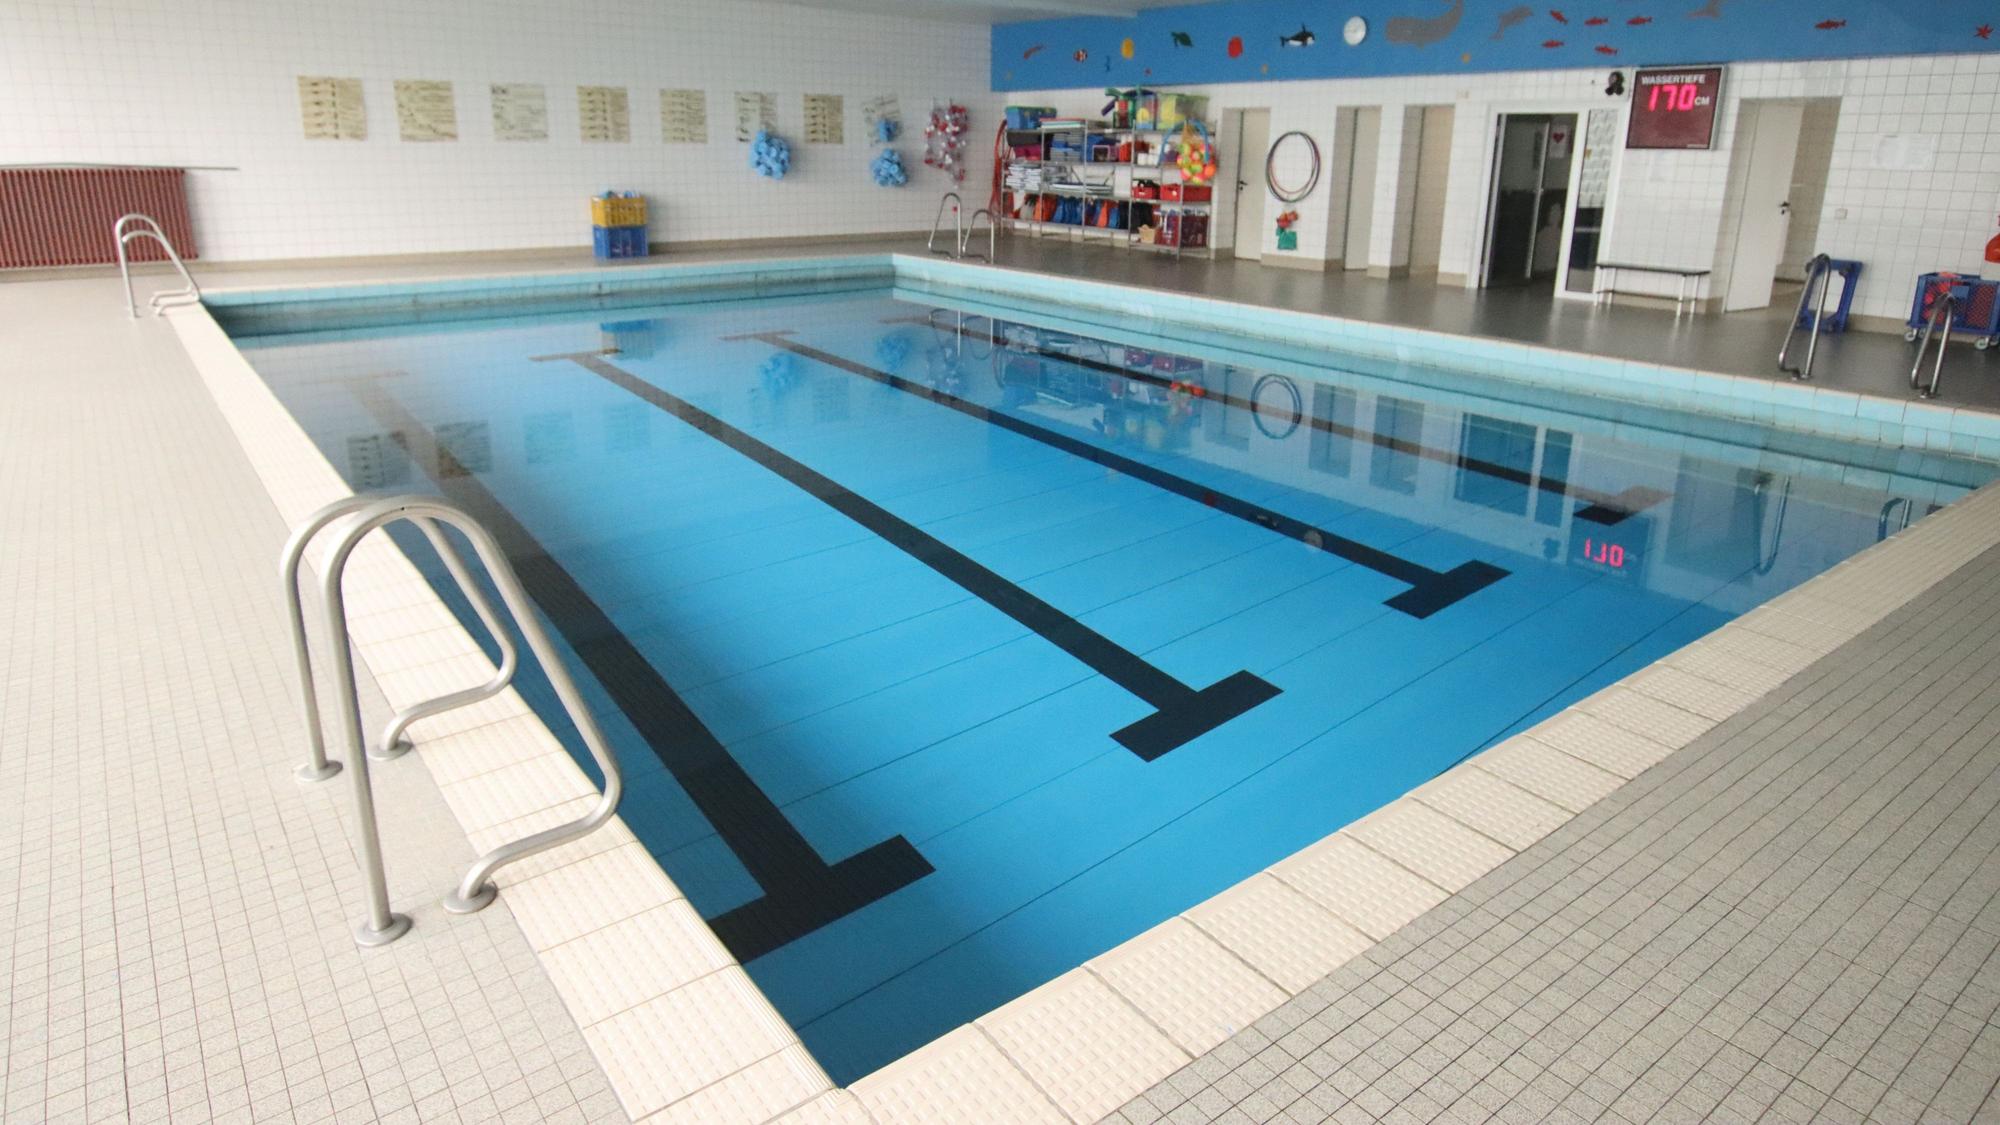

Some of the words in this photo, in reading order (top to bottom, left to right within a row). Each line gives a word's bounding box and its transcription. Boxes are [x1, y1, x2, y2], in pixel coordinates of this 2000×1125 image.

[1641, 74, 1706, 85] WASSERTIEFE
[1648, 84, 1697, 112] 170
[1695, 95, 1710, 106] CM
